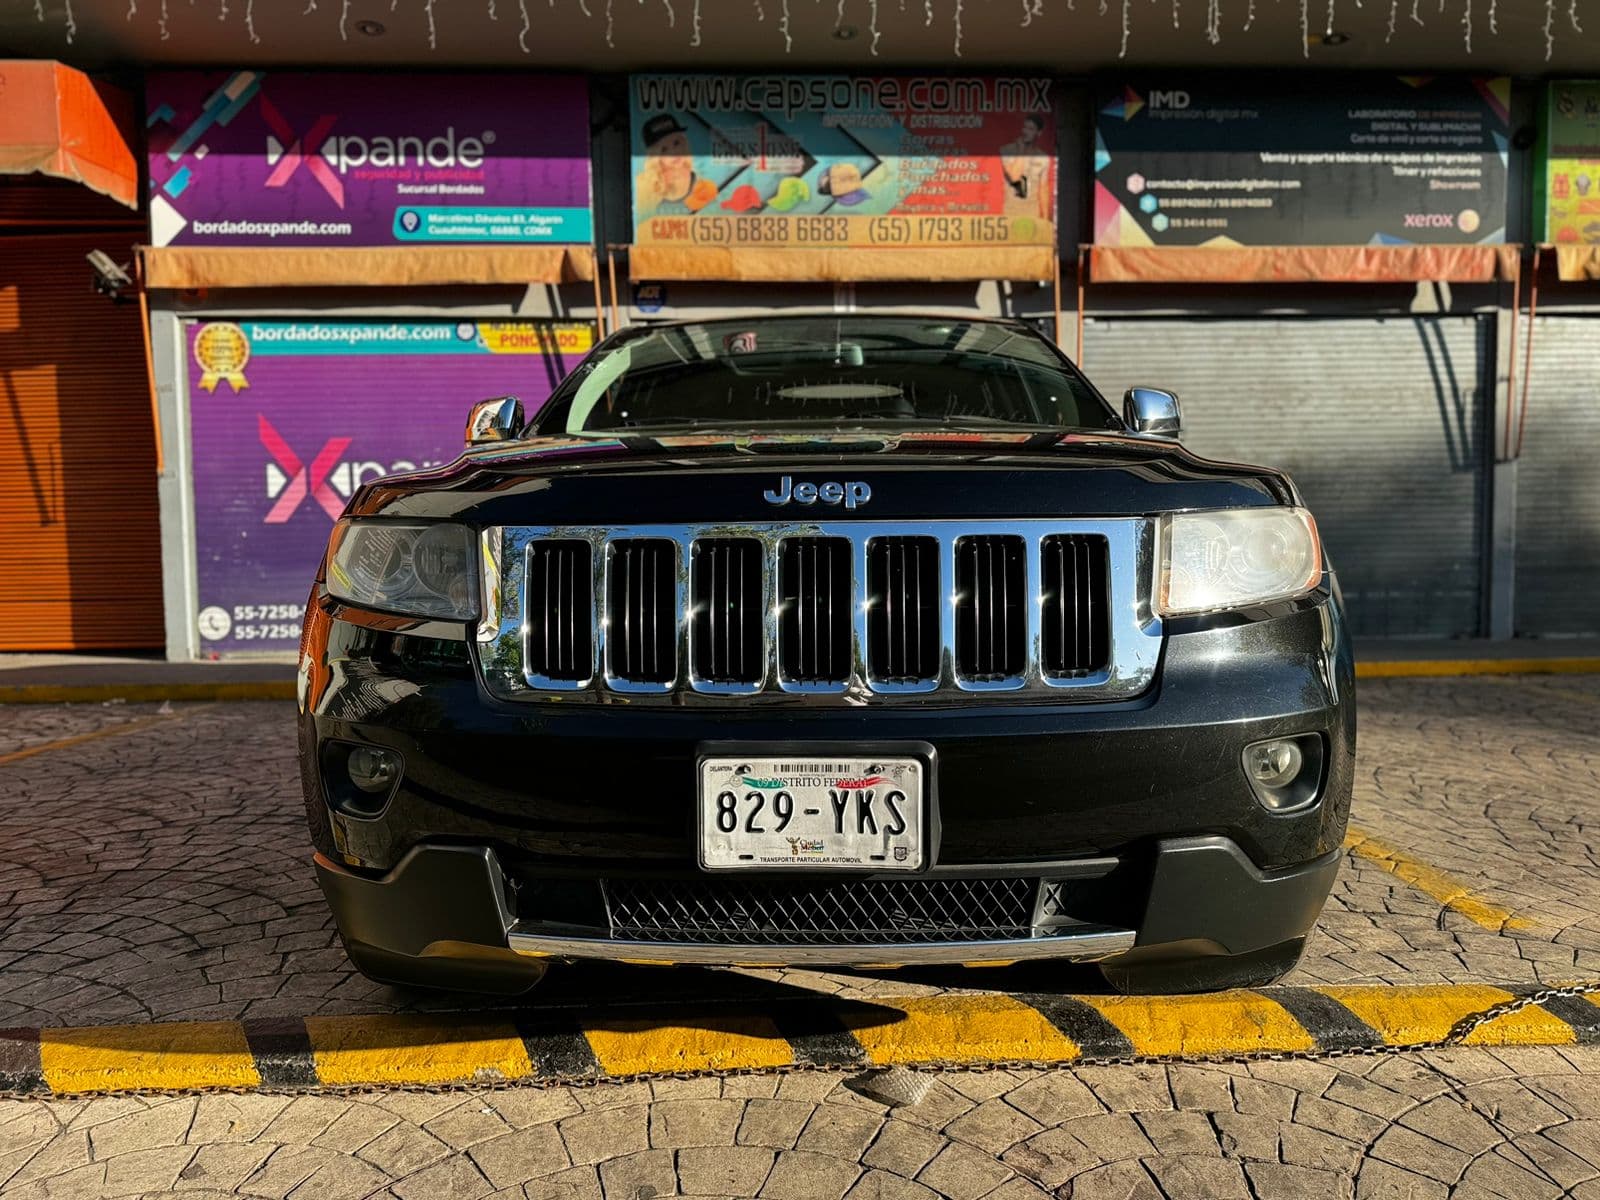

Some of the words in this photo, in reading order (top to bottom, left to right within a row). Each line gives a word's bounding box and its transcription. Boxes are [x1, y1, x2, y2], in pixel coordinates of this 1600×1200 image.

[637, 77, 1052, 120] www.capsone.com.mx
[1149, 90, 1190, 110] IMD
[1371, 153, 1382, 163] de
[1423, 153, 1434, 163] de
[397, 184, 438, 194] Sucursal
[439, 184, 485, 194] Bordados
[192, 218, 352, 236] bordadosxpande.com
[1404, 212, 1453, 228] xerox
[691, 217, 731, 244] (55)
[737, 218, 789, 242] 6838
[797, 218, 848, 242] 6683
[869, 217, 911, 244] (55)
[919, 218, 962, 242] 1793
[970, 218, 1009, 242] 1155
[252, 323, 450, 343] bordadosxpande.com
[763, 475, 872, 509] Jeep
[234, 604, 307, 621] 55-7258-
[771, 777, 821, 787] DISTRITO
[760, 856, 796, 864] TRANSPORTE
[797, 856, 831, 864] PARTICULAR
